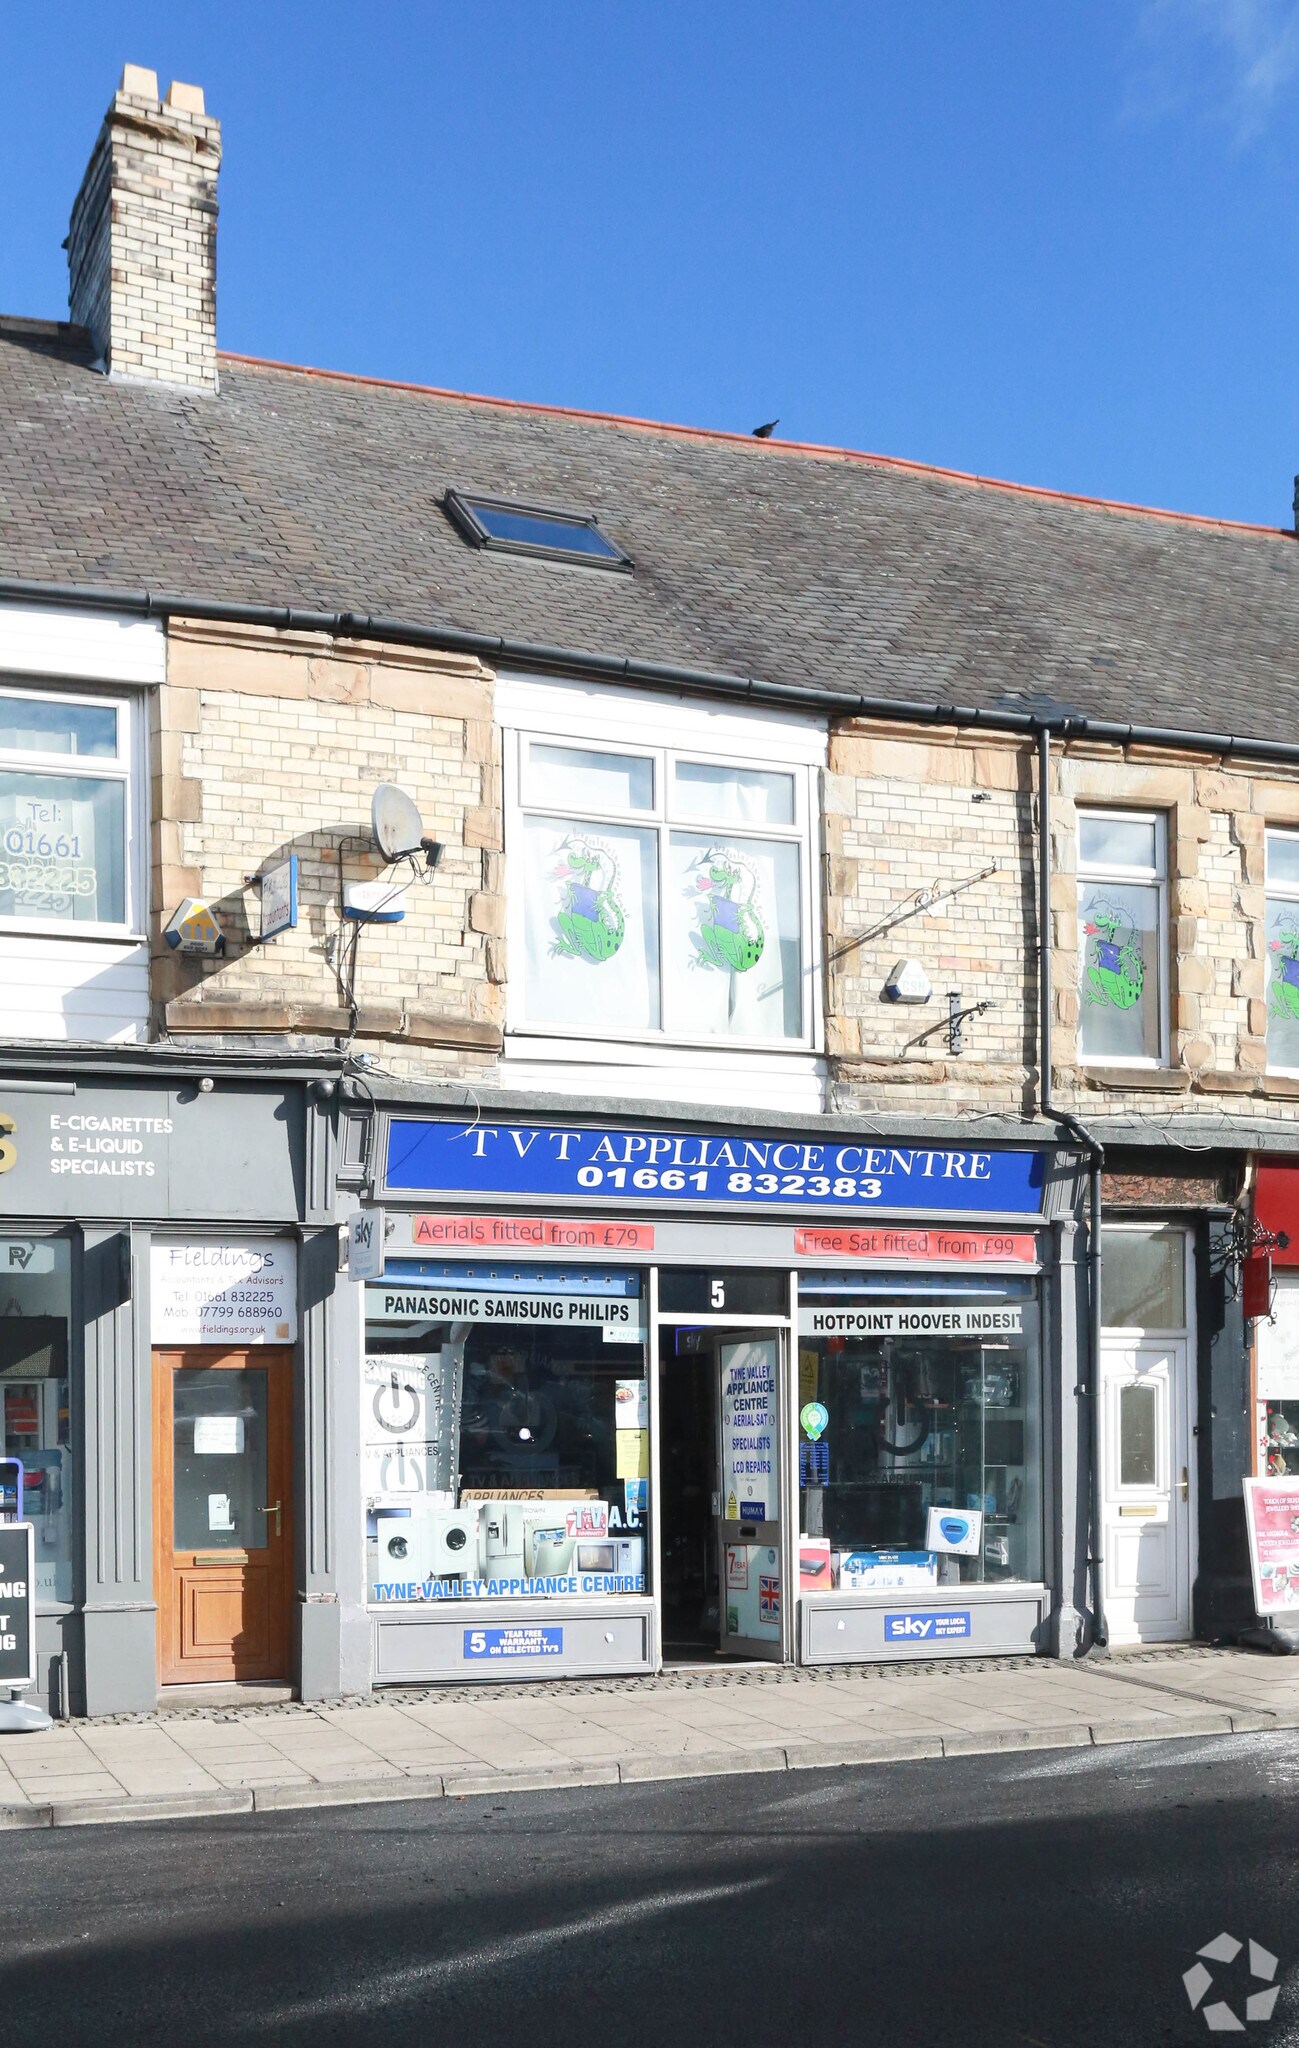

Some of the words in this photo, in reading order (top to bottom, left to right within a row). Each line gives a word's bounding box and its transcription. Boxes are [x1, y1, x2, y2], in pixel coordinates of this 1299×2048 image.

[27, 802, 62, 823] Tel:
[5, 829, 82, 859] 01661
[50, 1115, 173, 1134] E-CIGARETTES
[50, 1137, 64, 1152] &
[69, 1137, 143, 1155] E-LIQUID
[465, 1129, 498, 1157] T
[508, 1131, 540, 1158] V
[549, 1133, 581, 1161] T
[588, 1135, 825, 1172] APPLIANCE
[835, 1146, 992, 1180] CENTRE
[50, 1159, 155, 1176] SPECIALISTS
[576, 1166, 709, 1192] 01661
[727, 1172, 883, 1199] 832383
[355, 1217, 374, 1249] sky
[417, 1220, 485, 1240] Aerials
[492, 1221, 543, 1241] fitted
[550, 1225, 595, 1245] from
[603, 1228, 638, 1247] £79
[803, 1232, 842, 1251] Free
[850, 1233, 878, 1251] Sat
[884, 1234, 928, 1252] fitted
[937, 1236, 977, 1255] from
[984, 1238, 1014, 1255] £99
[169, 1246, 274, 1273] Fieldings
[246, 1276, 284, 1285] Advisors
[195, 1291, 226, 1302] 01661
[230, 1292, 274, 1302] 832225
[711, 1280, 725, 1308] 5
[195, 1307, 234, 1317] 07799
[238, 1307, 283, 1318] 688960
[384, 1296, 479, 1317] PANASONIC
[484, 1299, 564, 1320] SAMSUNG
[568, 1302, 630, 1322] PHILIPS
[813, 1314, 893, 1331] HOTPOINT
[898, 1314, 962, 1330] HOOVER
[730, 1368, 746, 1381] TYNE
[747, 1365, 771, 1380] VALLEY
[727, 1380, 775, 1396] APPLIANCE
[733, 1396, 768, 1412] CENTRE
[733, 1413, 768, 1428] AERIAL-SAT
[732, 1437, 771, 1450] SPECIALISTS
[732, 1461, 745, 1474] LCD
[745, 1460, 771, 1474] REPAIRS
[728, 1552, 736, 1574] 7
[373, 1582, 418, 1600] TYNE
[420, 1579, 484, 1599] VALLEY
[487, 1577, 578, 1597] APPLIANCE
[582, 1574, 645, 1593] CENTRE
[891, 1617, 932, 1637] sky
[935, 1618, 949, 1626] YOUR
[950, 1617, 966, 1625] LOCAL
[935, 1627, 946, 1635] SKY
[947, 1626, 966, 1634] EXPERT
[470, 1631, 486, 1653] 5
[503, 1630, 523, 1638] YEAR
[524, 1629, 543, 1637] FREE
[489, 1646, 501, 1654] ON
[502, 1645, 541, 1654] SELECTED
[542, 1644, 559, 1653] TV'S
[499, 1637, 548, 1646] WARRANTY
